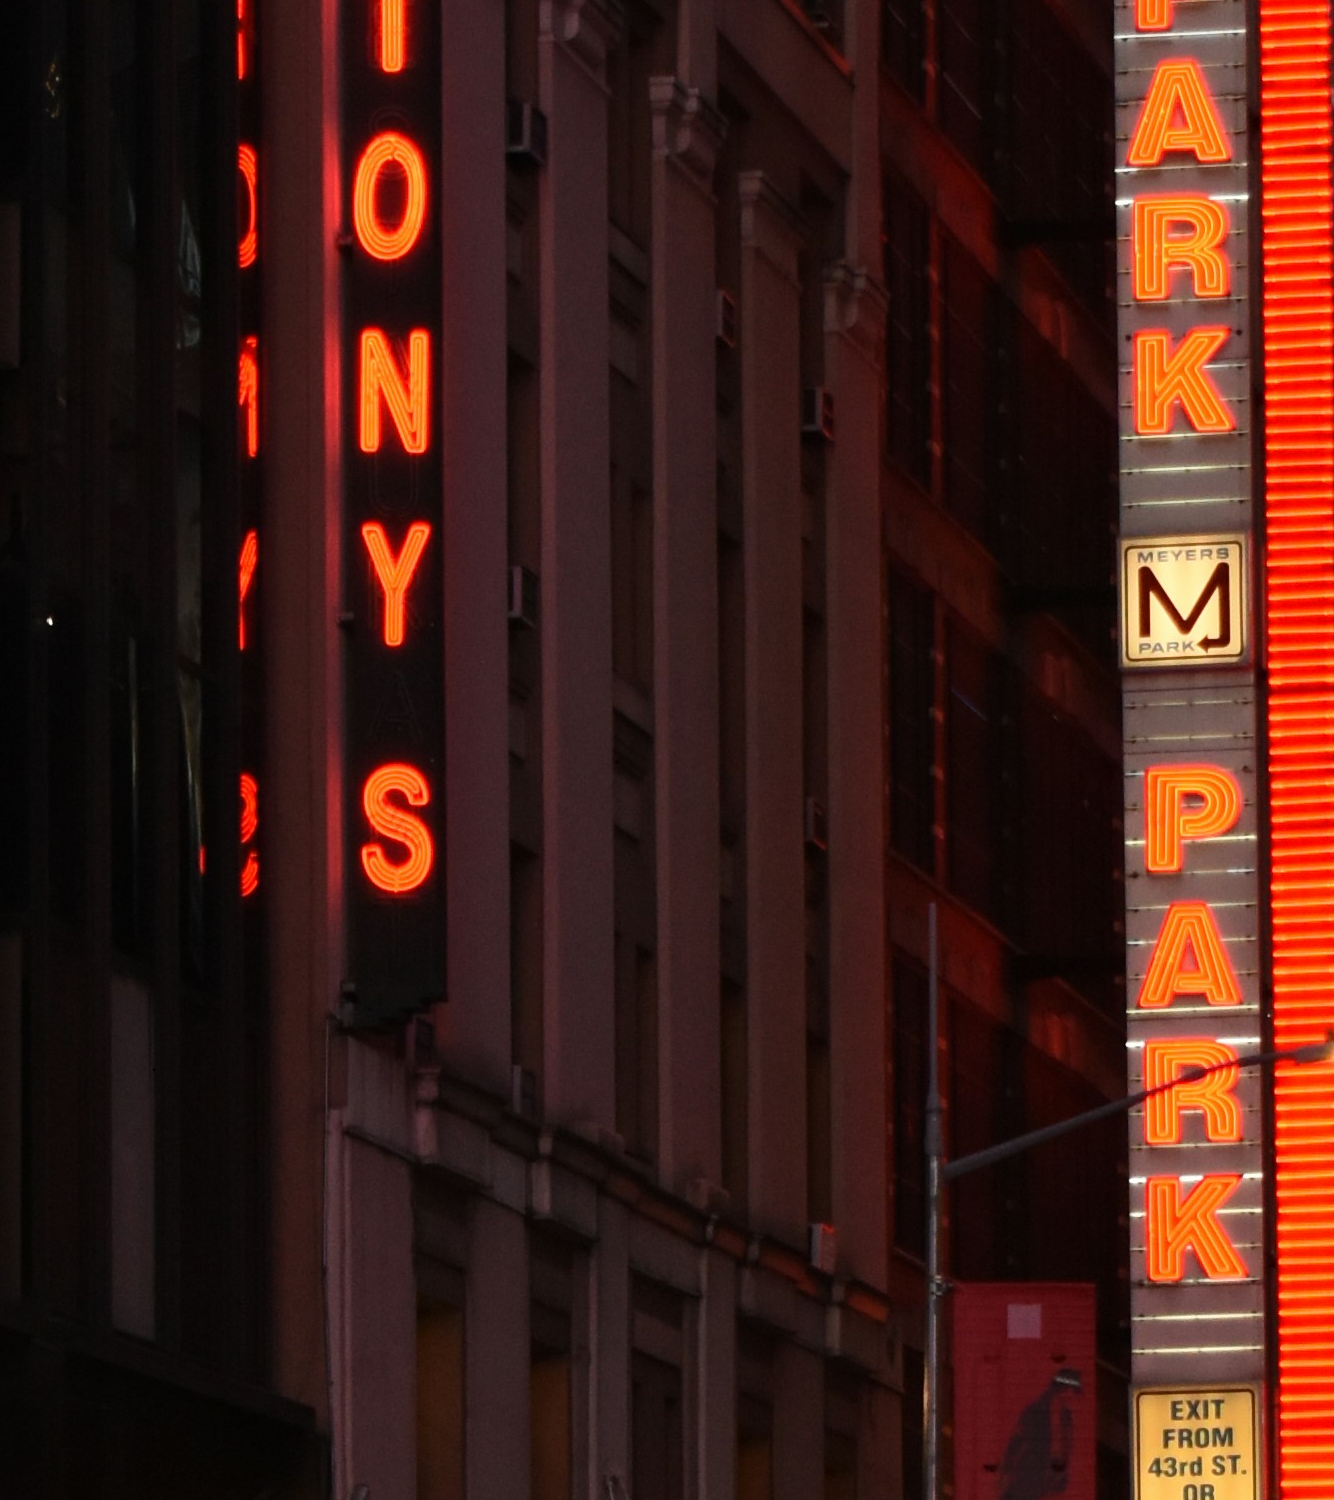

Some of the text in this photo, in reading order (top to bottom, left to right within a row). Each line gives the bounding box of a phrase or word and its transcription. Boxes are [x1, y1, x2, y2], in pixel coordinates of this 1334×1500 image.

[1137, 547, 1229, 563] MEYERS
[1138, 641, 1195, 655] PARK
[1139, 764, 1249, 1283] PARK
[1170, 1399, 1225, 1421] EXIT
[1162, 1427, 1234, 1449] FROM
[1147, 1453, 1247, 1478] 43rd ST.
